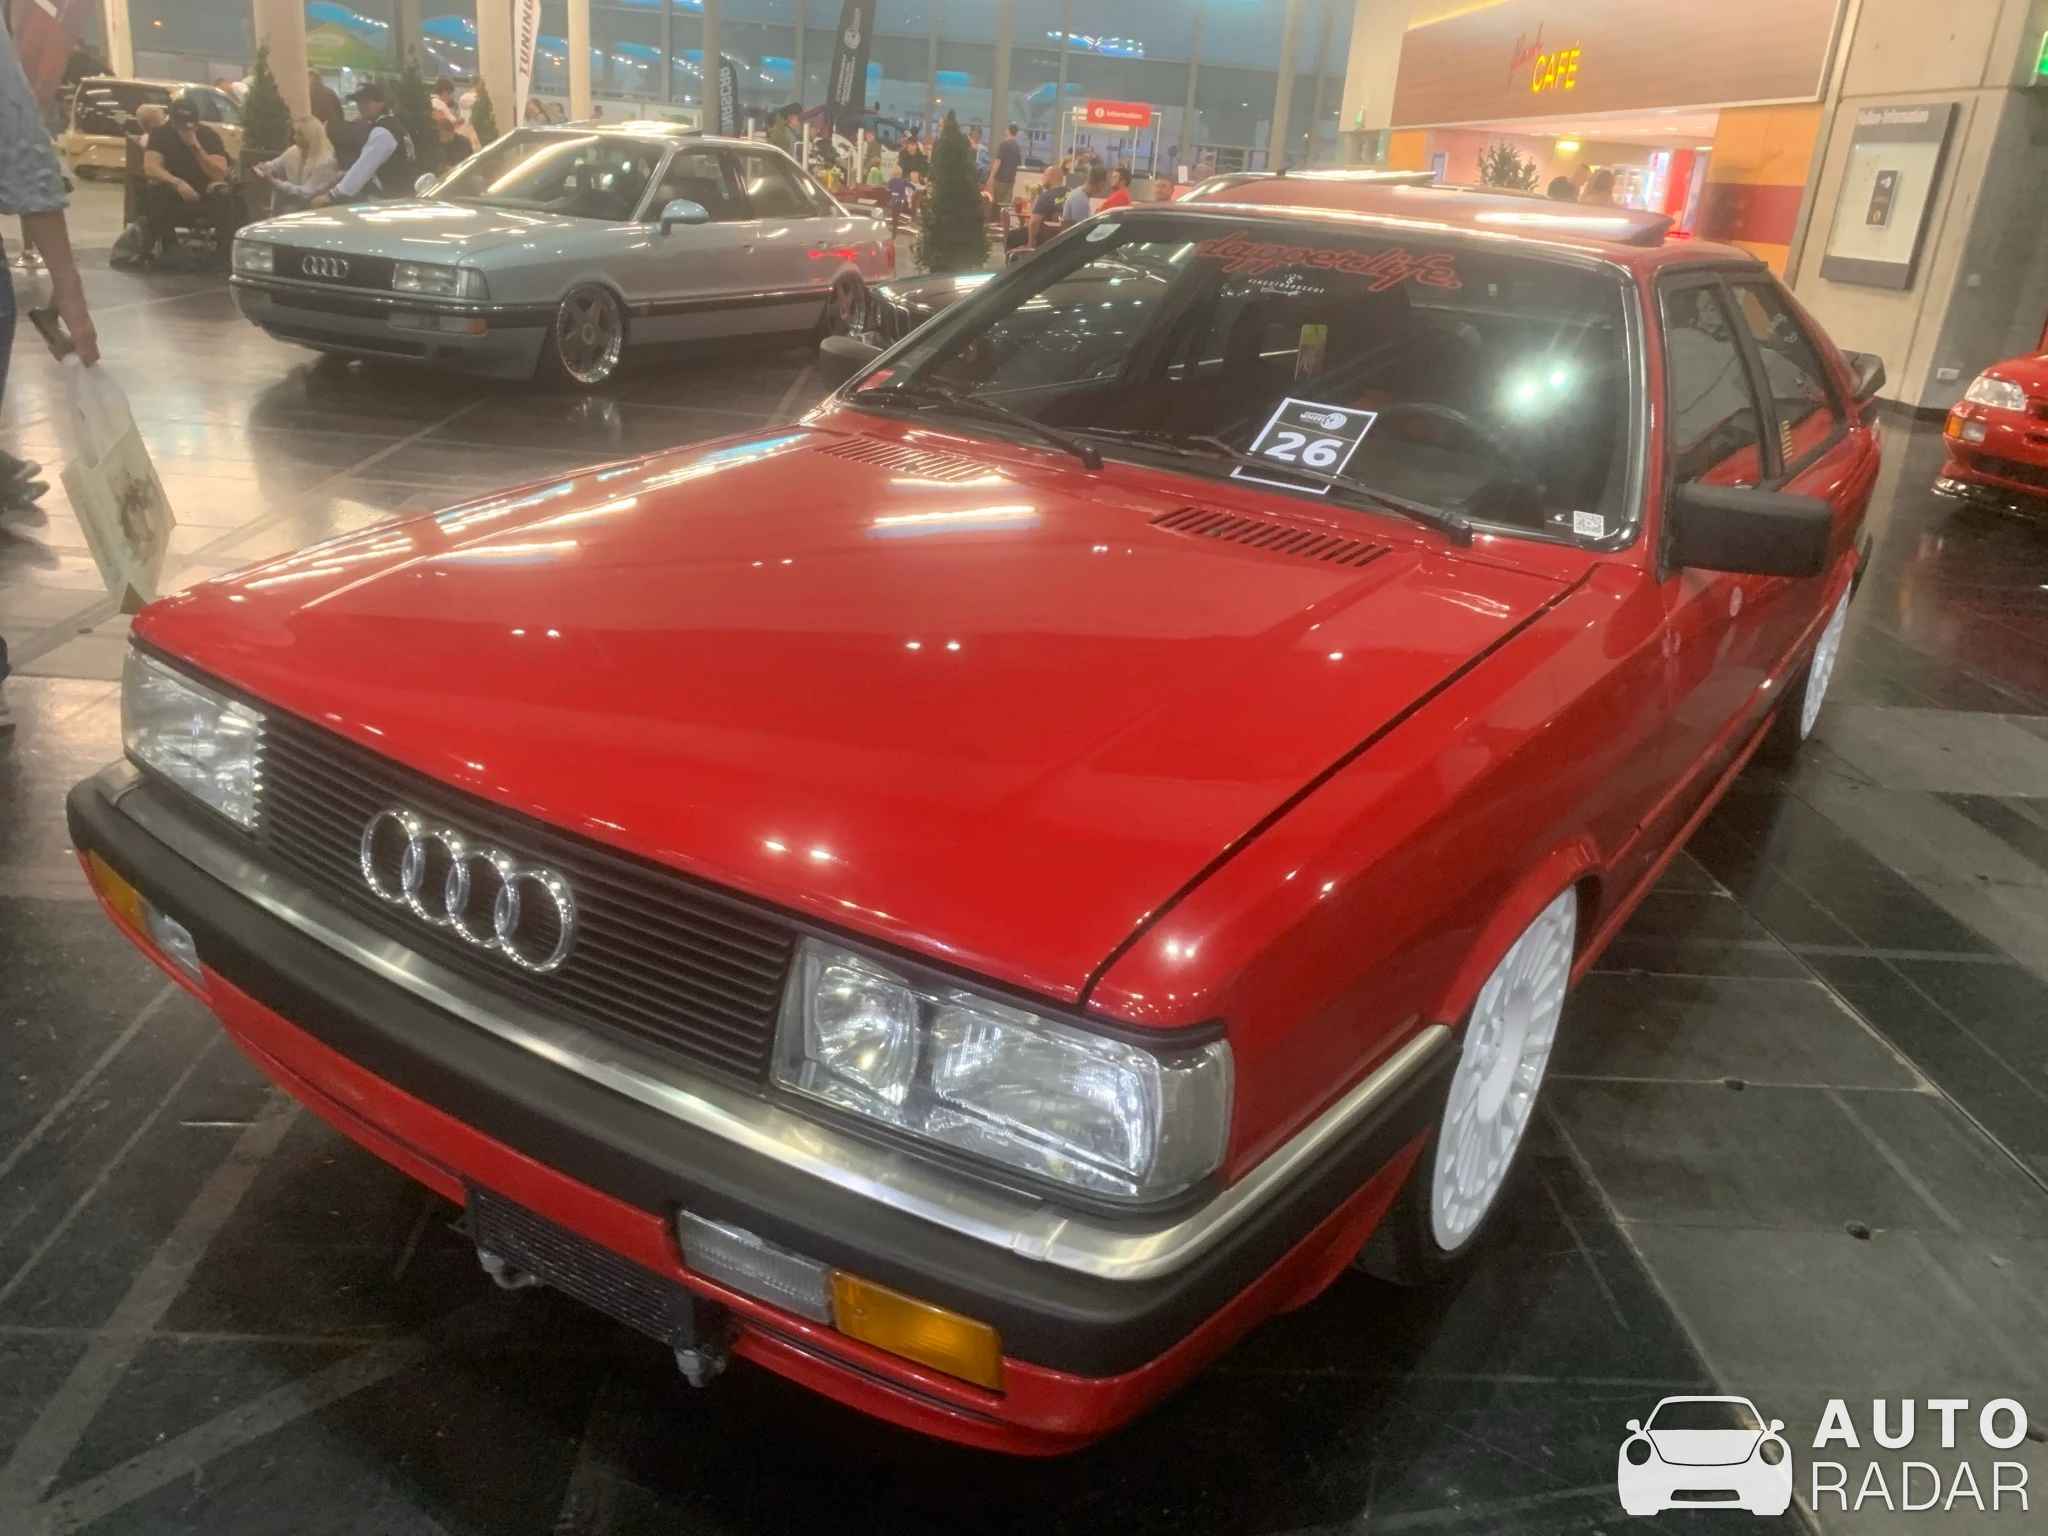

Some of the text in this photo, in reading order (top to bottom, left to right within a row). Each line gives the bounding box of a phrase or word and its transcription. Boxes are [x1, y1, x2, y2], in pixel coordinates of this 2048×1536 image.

[1531, 40, 1580, 93] CAFÉ
[1106, 110, 1143, 120] Information
[1263, 431, 1344, 467] 26
